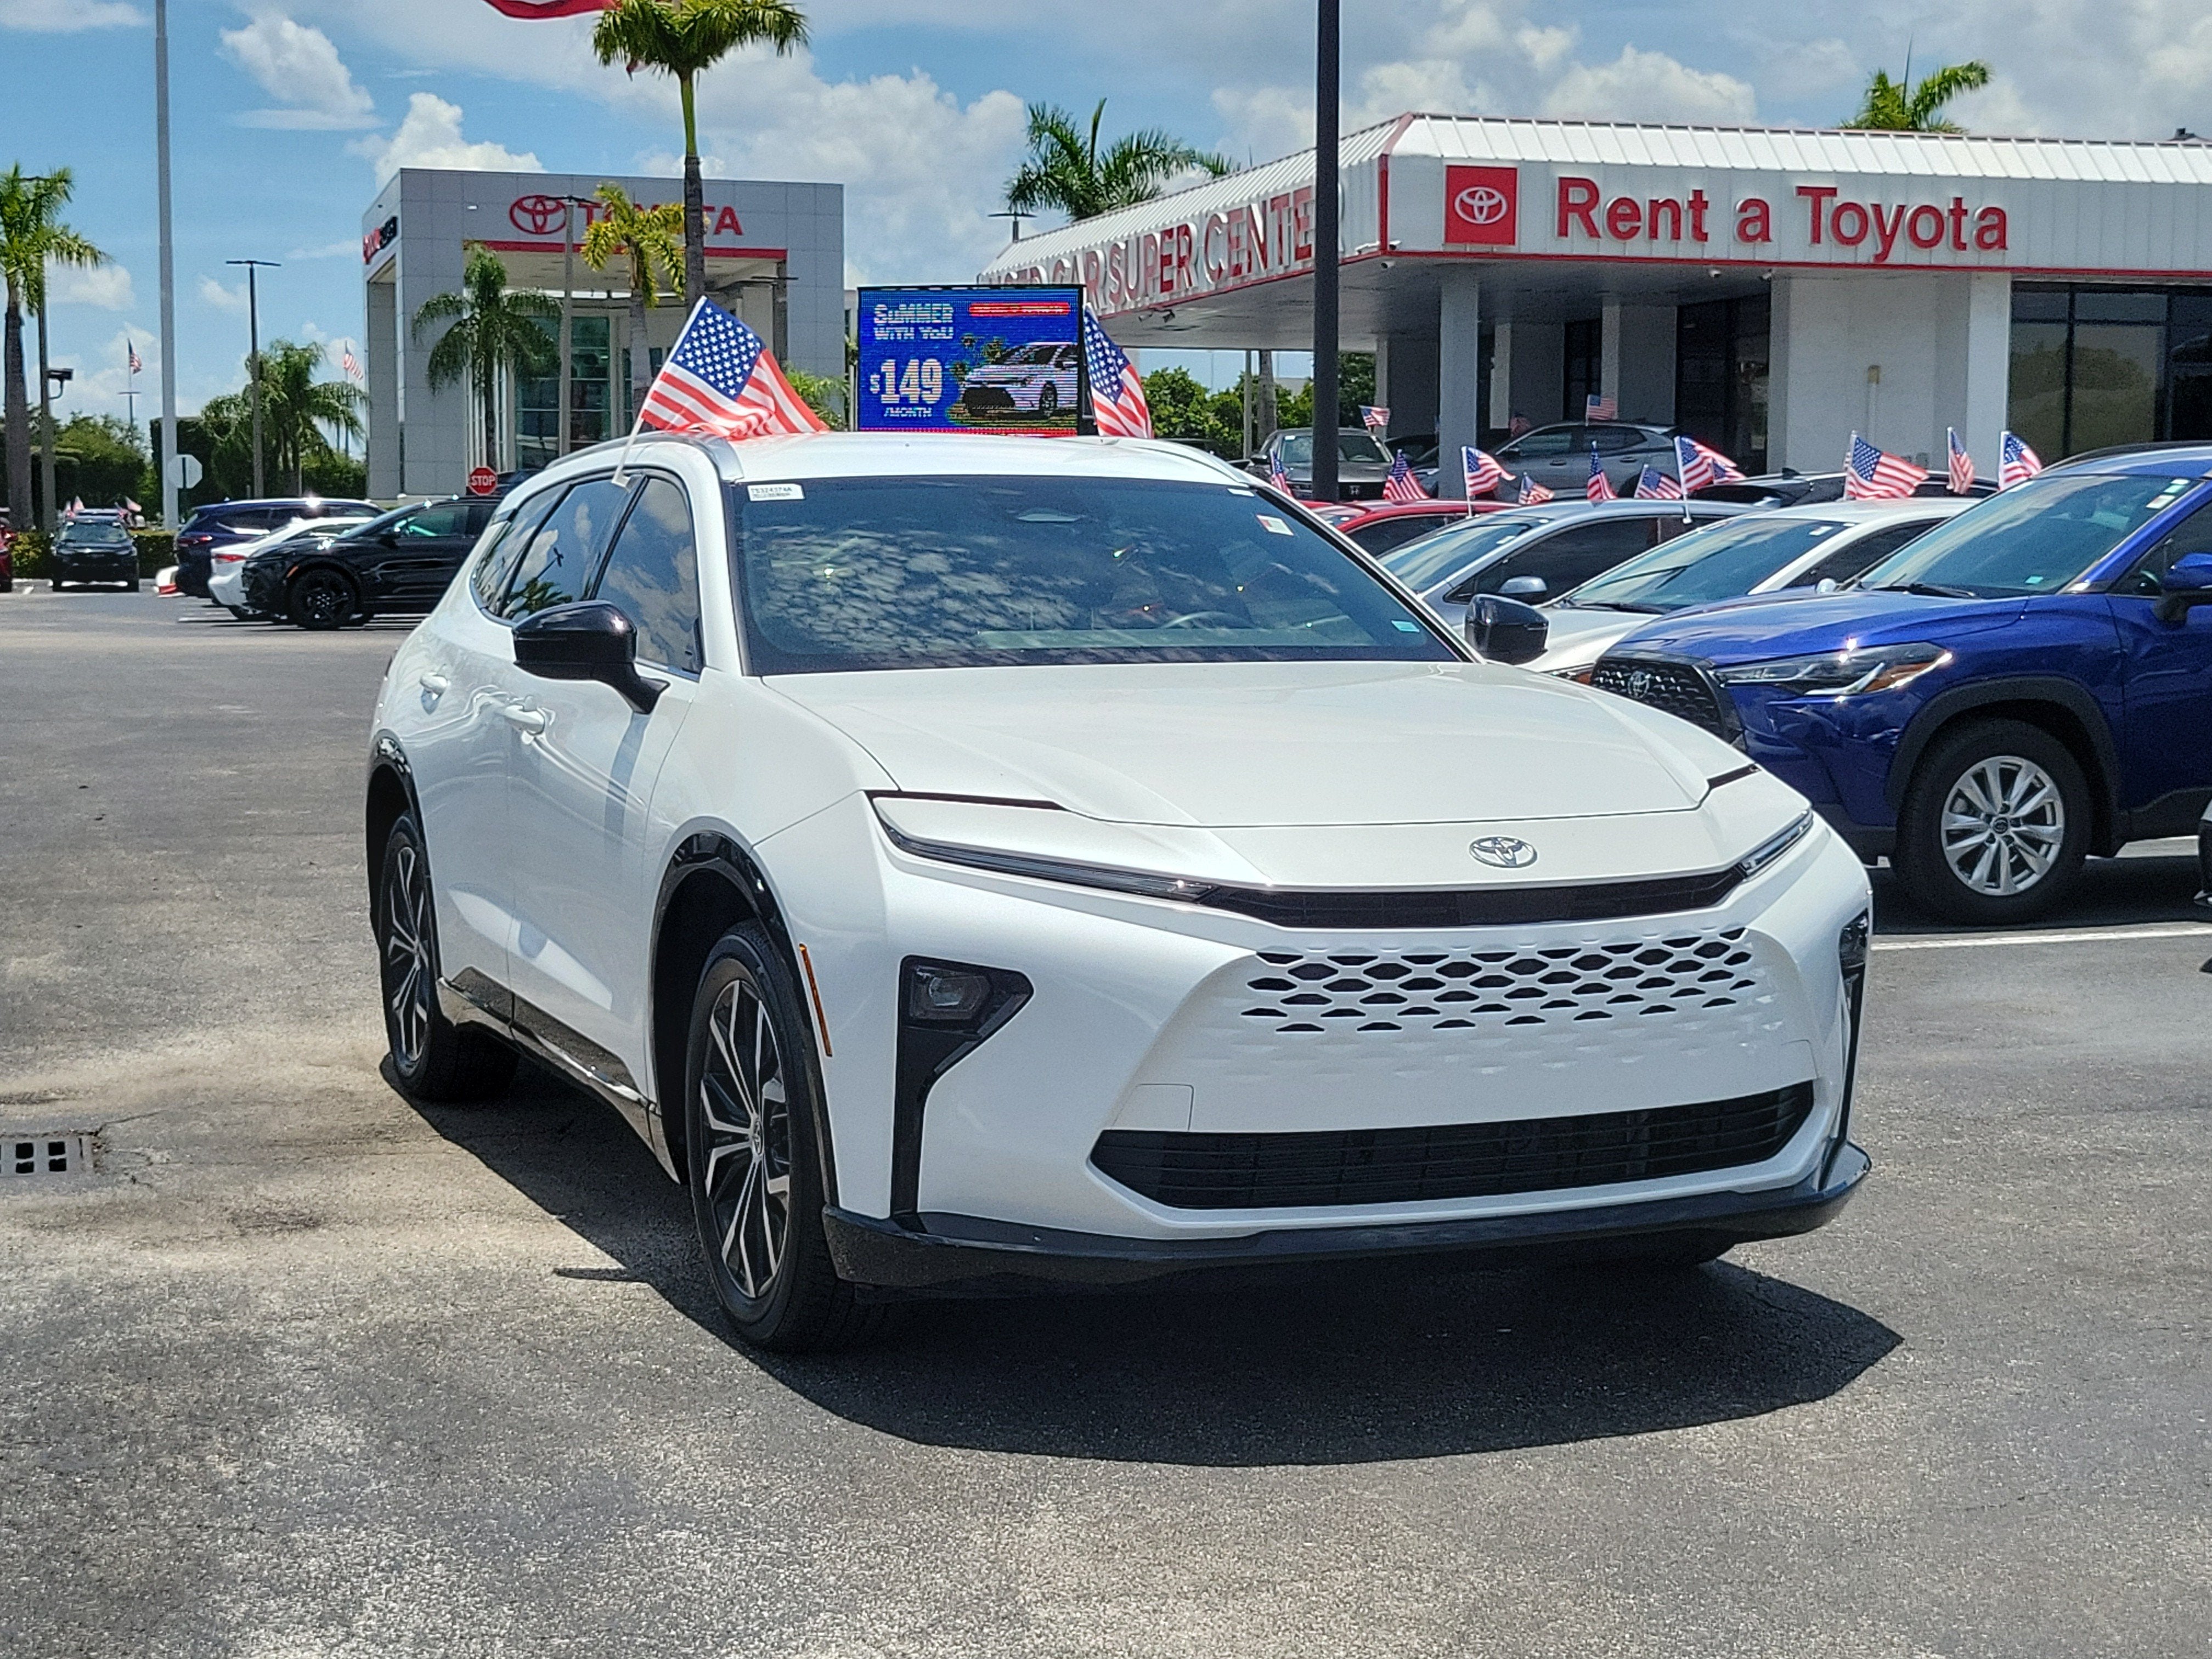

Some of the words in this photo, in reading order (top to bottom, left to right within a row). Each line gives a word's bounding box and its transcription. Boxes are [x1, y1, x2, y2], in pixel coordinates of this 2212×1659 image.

[1557, 176, 1709, 243] Rent
[1735, 198, 1771, 243] a
[1795, 185, 2008, 263] Toyota
[1108, 222, 1197, 306] SUPER
[1205, 184, 1314, 284] CENTE
[873, 303, 954, 324] SUMMER
[870, 358, 943, 404] $149
[471, 475, 495, 486] STOP
